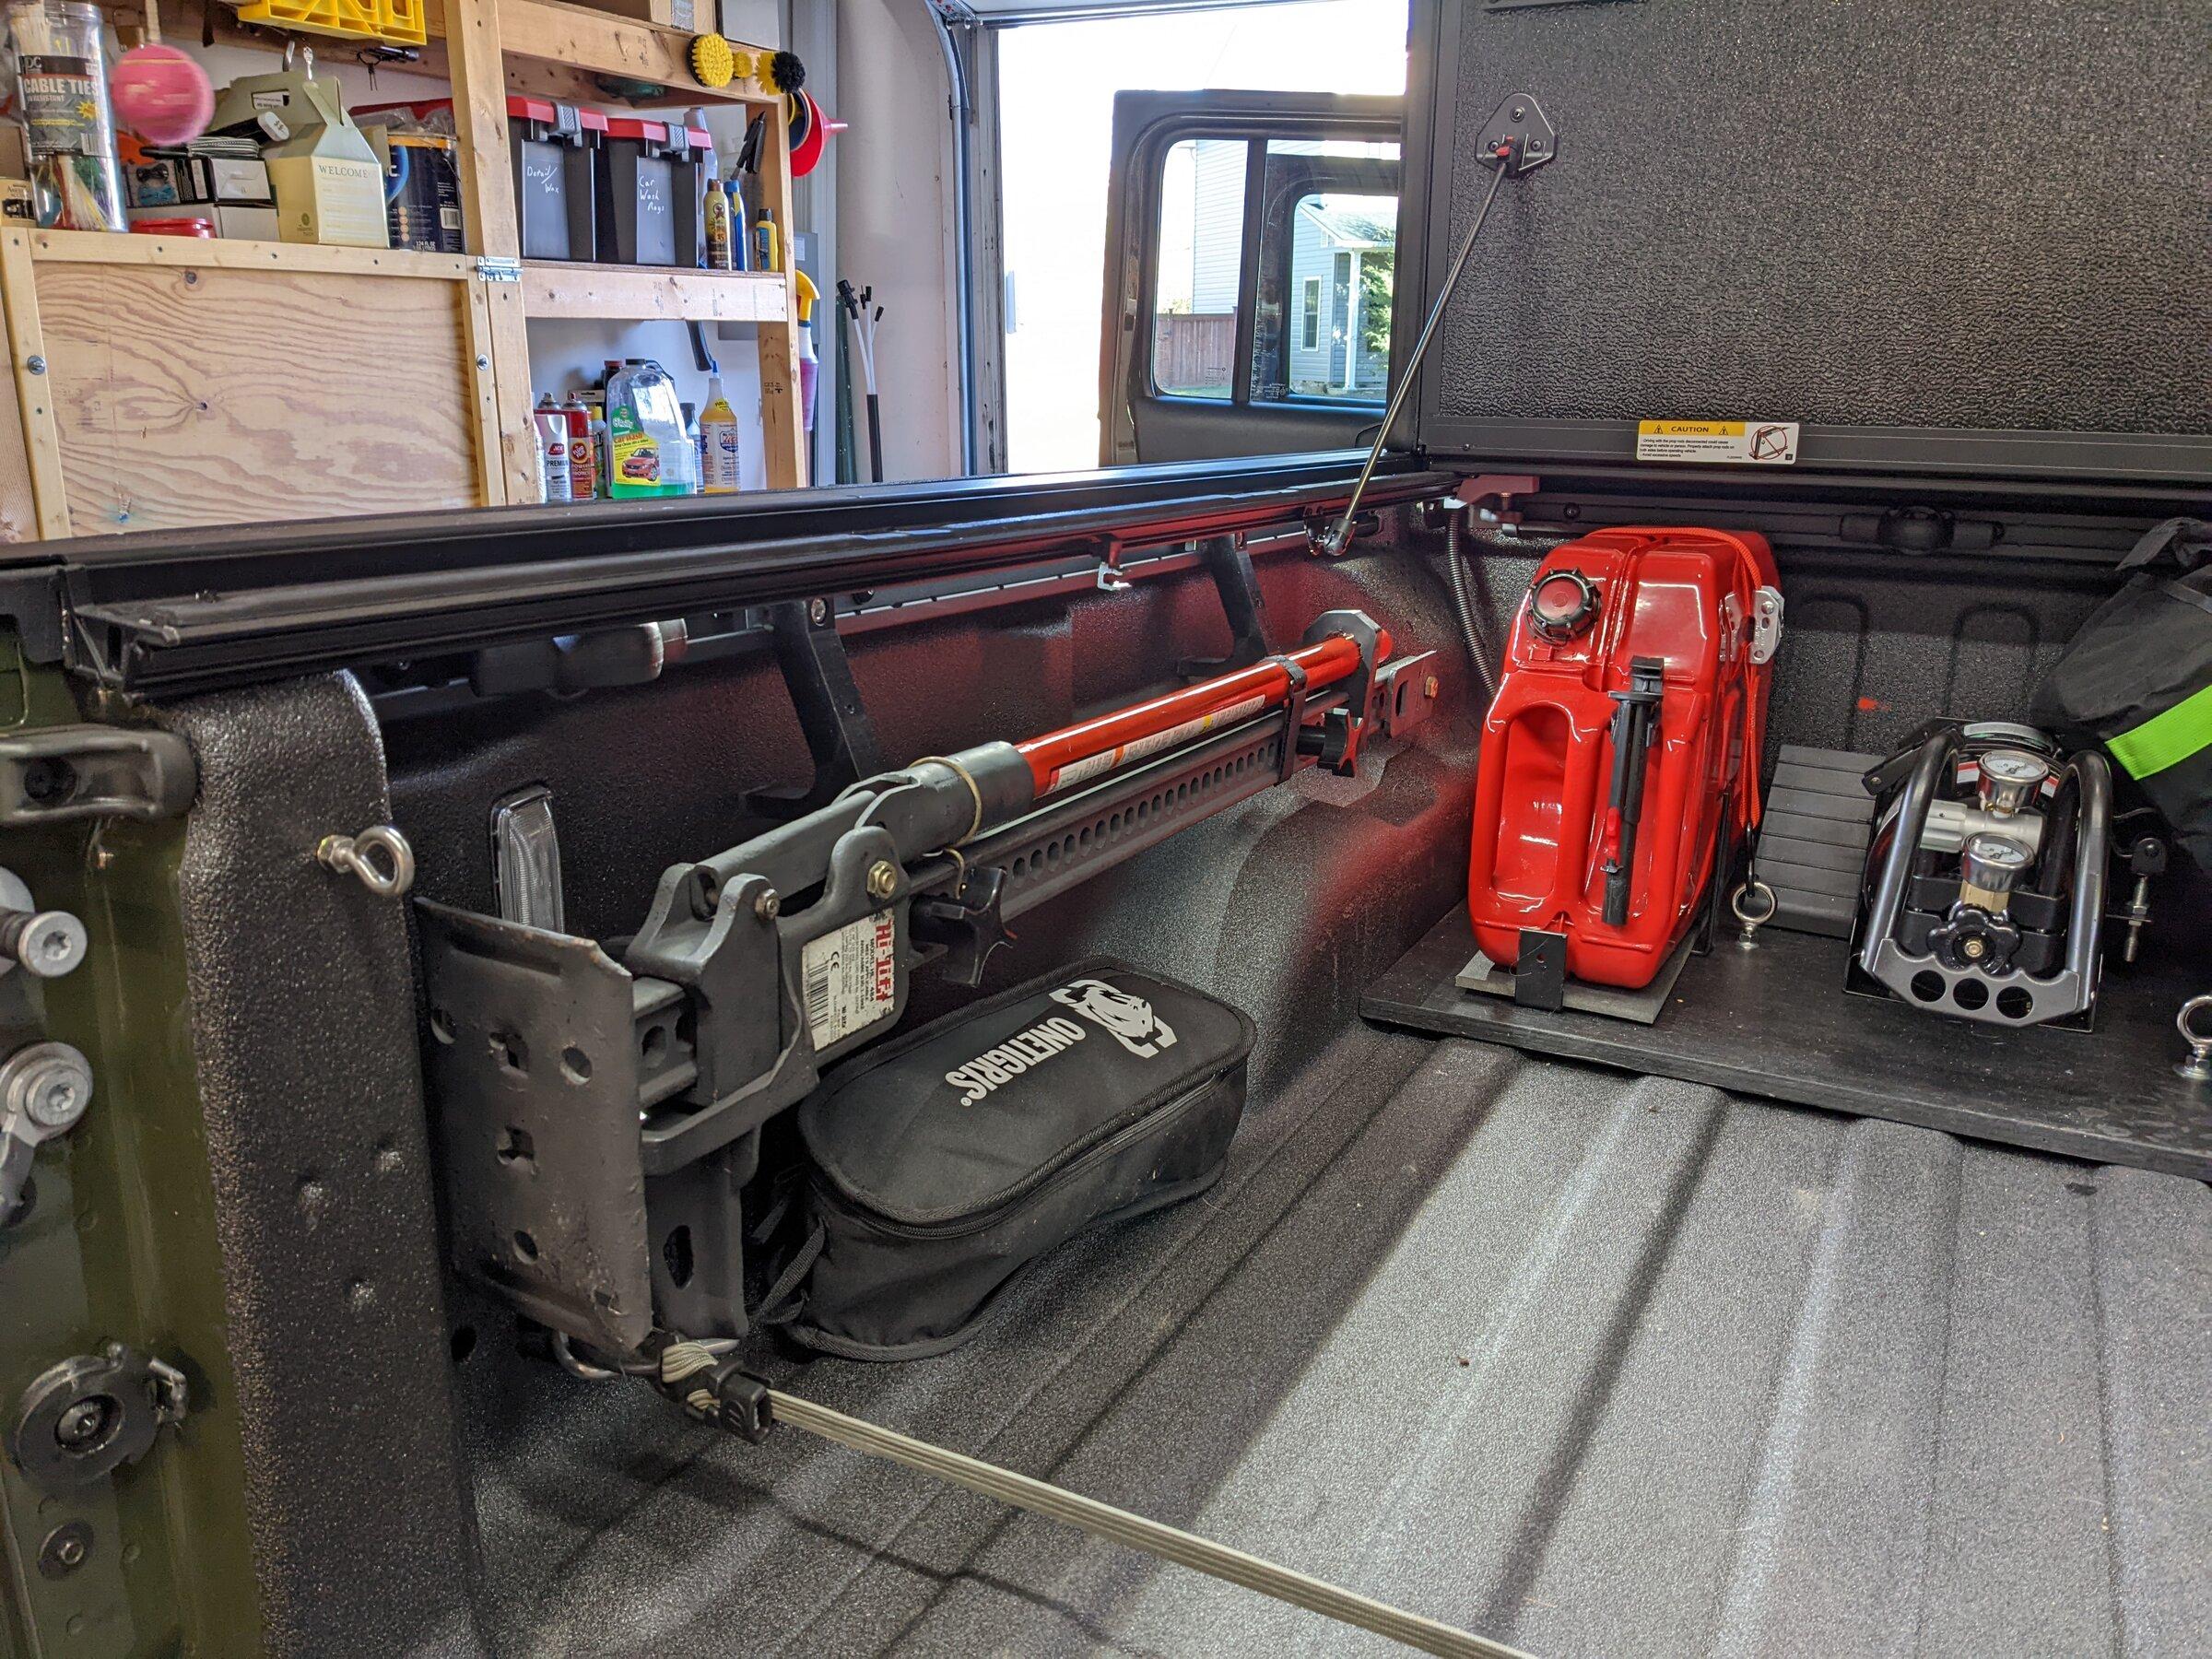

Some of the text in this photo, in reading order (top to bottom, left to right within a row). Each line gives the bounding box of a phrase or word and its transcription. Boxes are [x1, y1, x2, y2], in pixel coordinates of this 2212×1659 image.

[23, 78, 99, 96] CABLE TIES
[318, 165, 369, 178] WELCOME
[639, 176, 655, 187] Car
[640, 189, 659, 201] Wash
[945, 1017, 1087, 1100] ONETIGRIS
